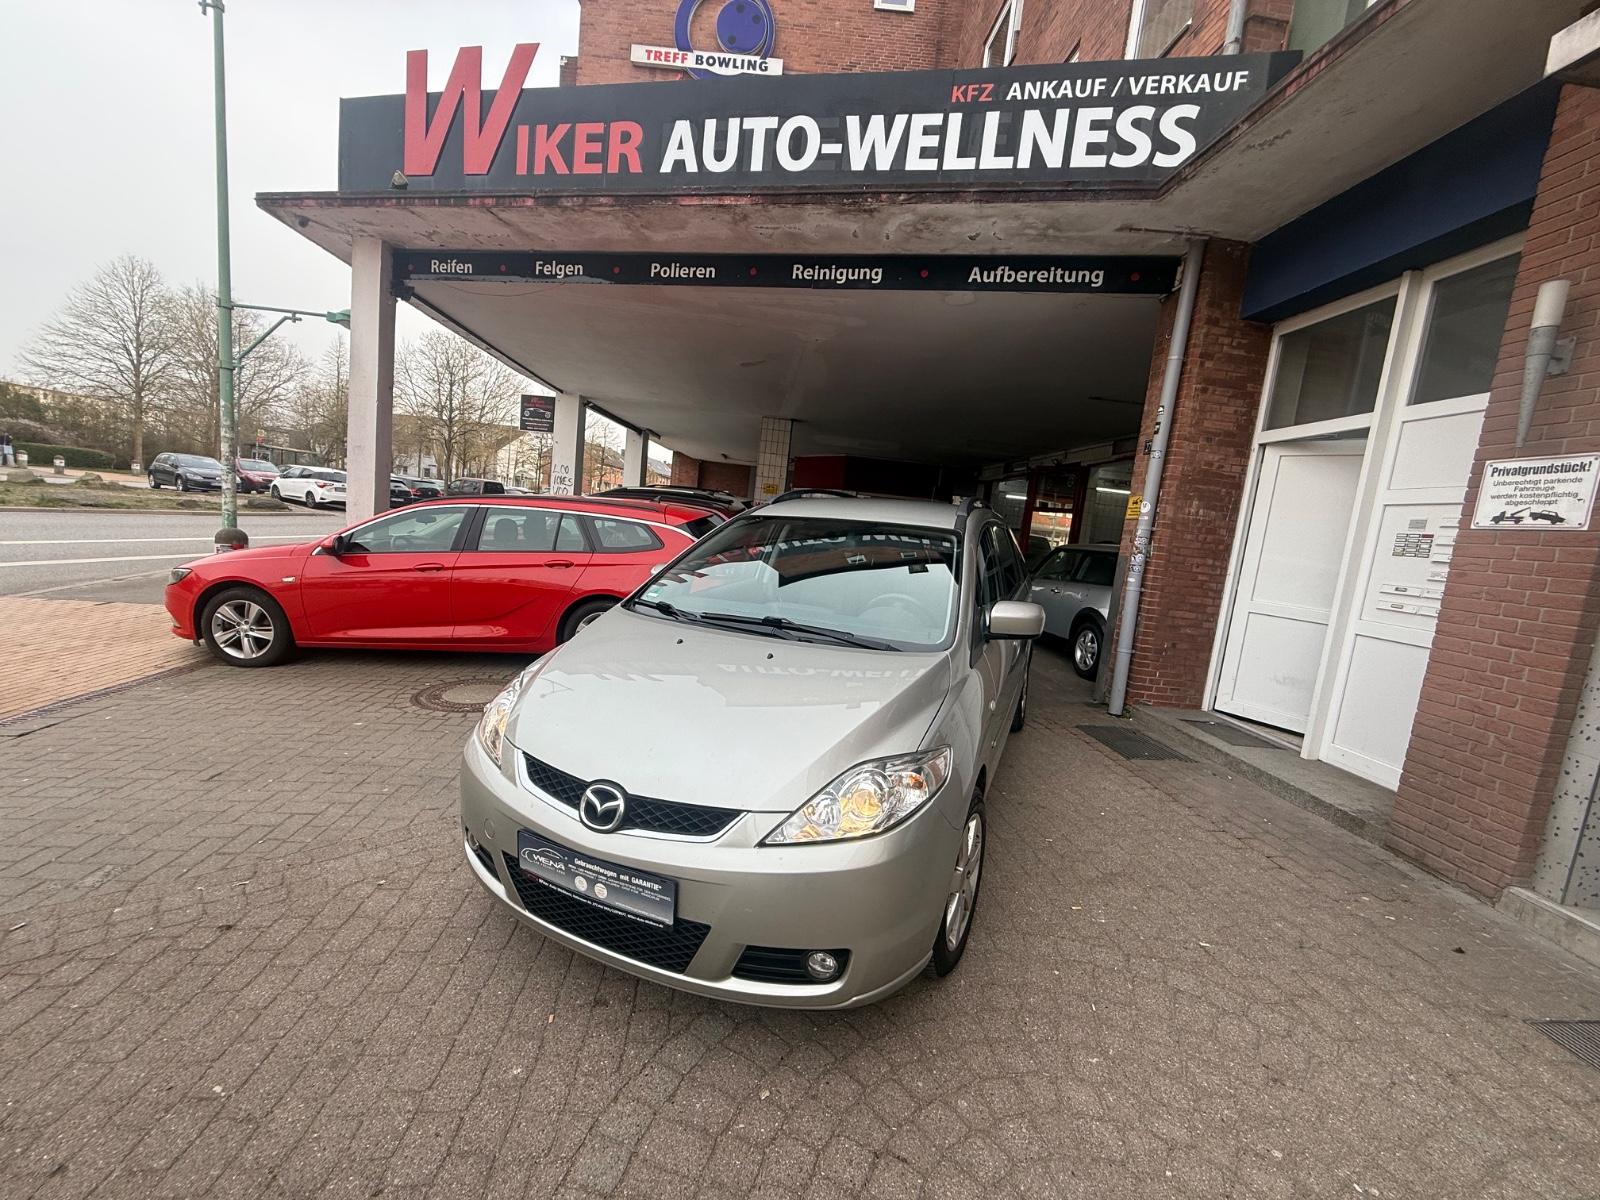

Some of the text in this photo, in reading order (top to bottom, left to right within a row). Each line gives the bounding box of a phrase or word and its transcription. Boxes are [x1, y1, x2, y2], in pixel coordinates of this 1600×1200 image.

[645, 49, 769, 72] TREFF BOWLING
[951, 83, 994, 103] KFZ
[1006, 77, 1107, 100] ANKAUF
[1128, 70, 1249, 96] VERKAUF
[404, 42, 1201, 177] WIKER AUTO-WELLNESS
[430, 259, 1104, 287] Reifen Felgen Polieren Reinigung Aufbereitung
[1490, 461, 1592, 477] Privatgrundstück!
[1543, 477, 1583, 485] parkende
[1519, 491, 1579, 499] kostenpflichtig
[574, 858, 618, 878] Gebrauchtwagen
[619, 873, 630, 882] mit
